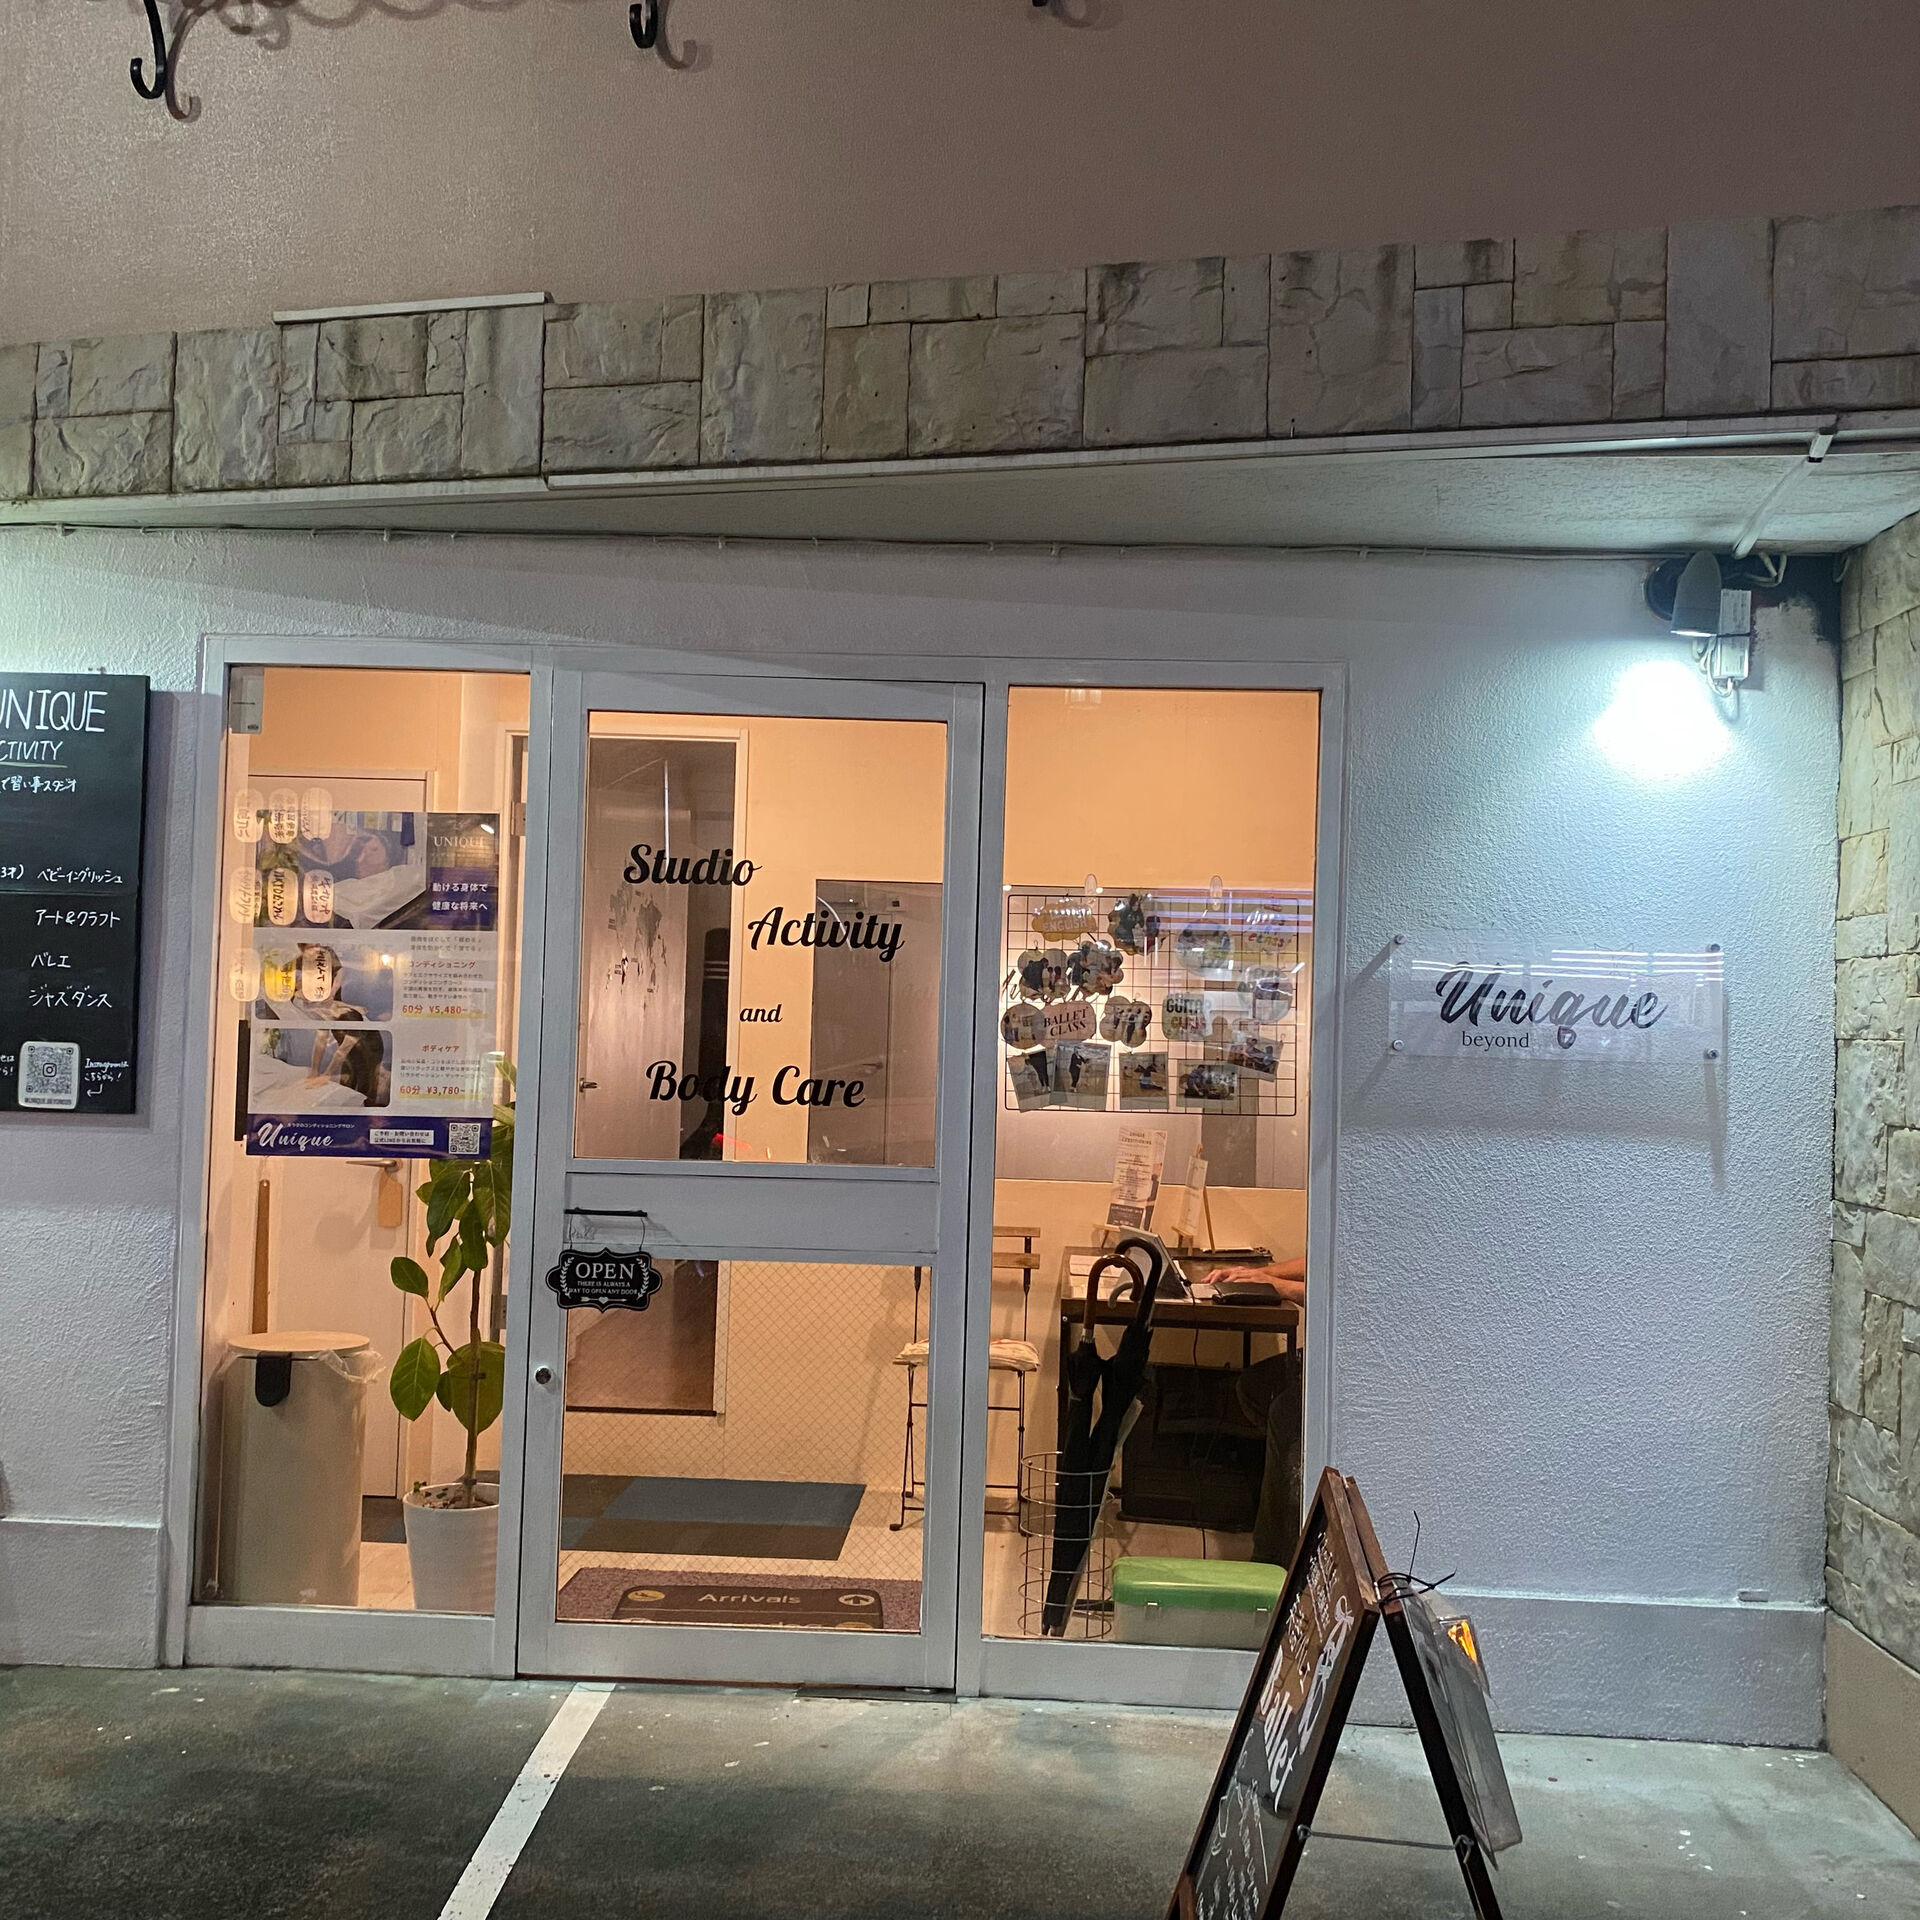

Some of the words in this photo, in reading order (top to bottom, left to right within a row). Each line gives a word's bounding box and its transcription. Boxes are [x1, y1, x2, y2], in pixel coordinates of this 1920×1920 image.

[623, 844, 763, 886] Studio
[37, 866, 123, 884] ベビーイングリッシュ
[432, 882, 488, 893] 動ける身体で
[432, 901, 488, 912] 健康な将来へ
[1043, 917, 1087, 932] ENGLISH
[748, 907, 905, 963] Activity
[31, 953, 71, 968] バレエ
[29, 984, 112, 1008] ジャズダンス
[1436, 961, 1669, 1049] Unique
[402, 1005, 423, 1014] 60分
[739, 1004, 782, 1023] and
[1044, 1008, 1088, 1028] BALLET
[1050, 1021, 1086, 1037] CLASS
[1462, 1031, 1529, 1051] beyond
[400, 1085, 420, 1095] 60分
[646, 1060, 757, 1116] Body
[772, 1065, 865, 1107] Care
[257, 1123, 334, 1152] Unique
[575, 1262, 635, 1279] OPEN
[698, 1593, 801, 1604] Arrivals
[1259, 1646, 1298, 1814] Ballet
